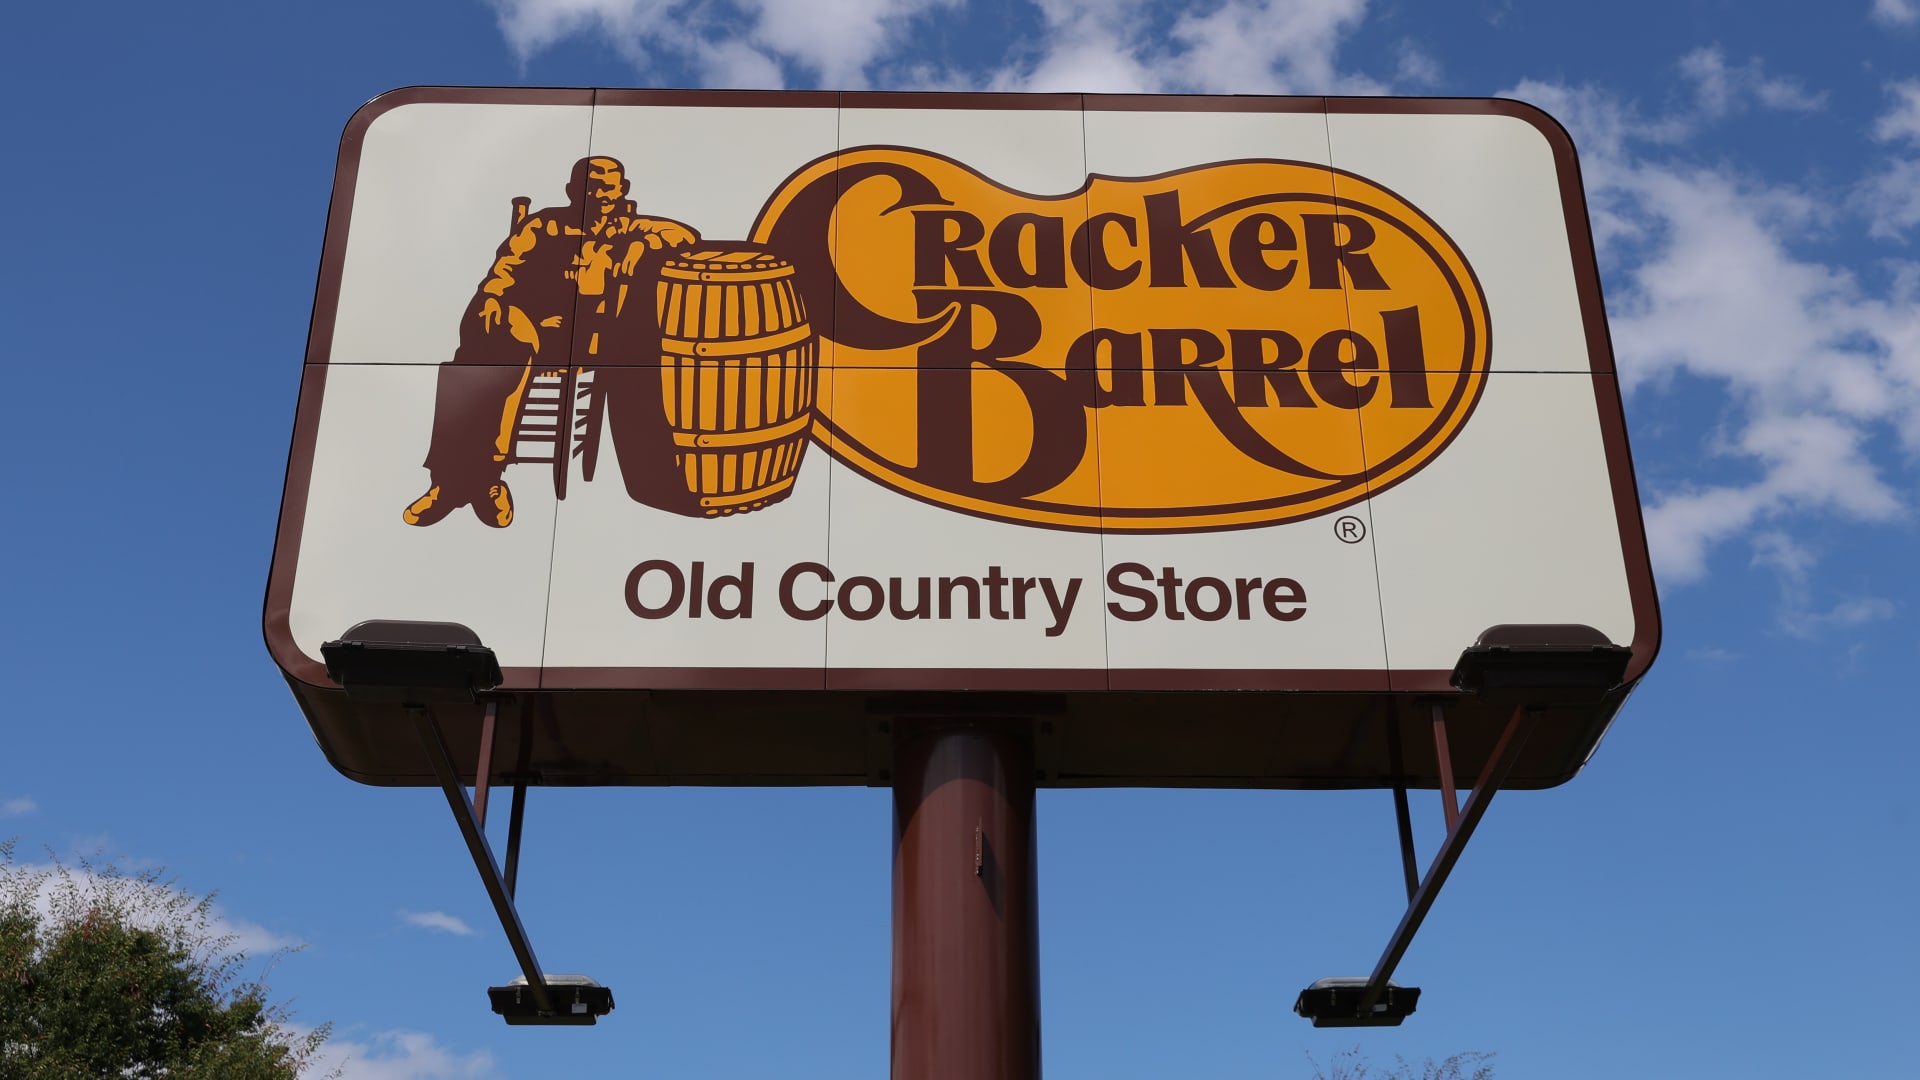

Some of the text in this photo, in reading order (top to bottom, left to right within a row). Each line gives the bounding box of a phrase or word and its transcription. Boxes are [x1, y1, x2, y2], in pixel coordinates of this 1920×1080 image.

[624, 559, 1307, 637] Old Country Store
